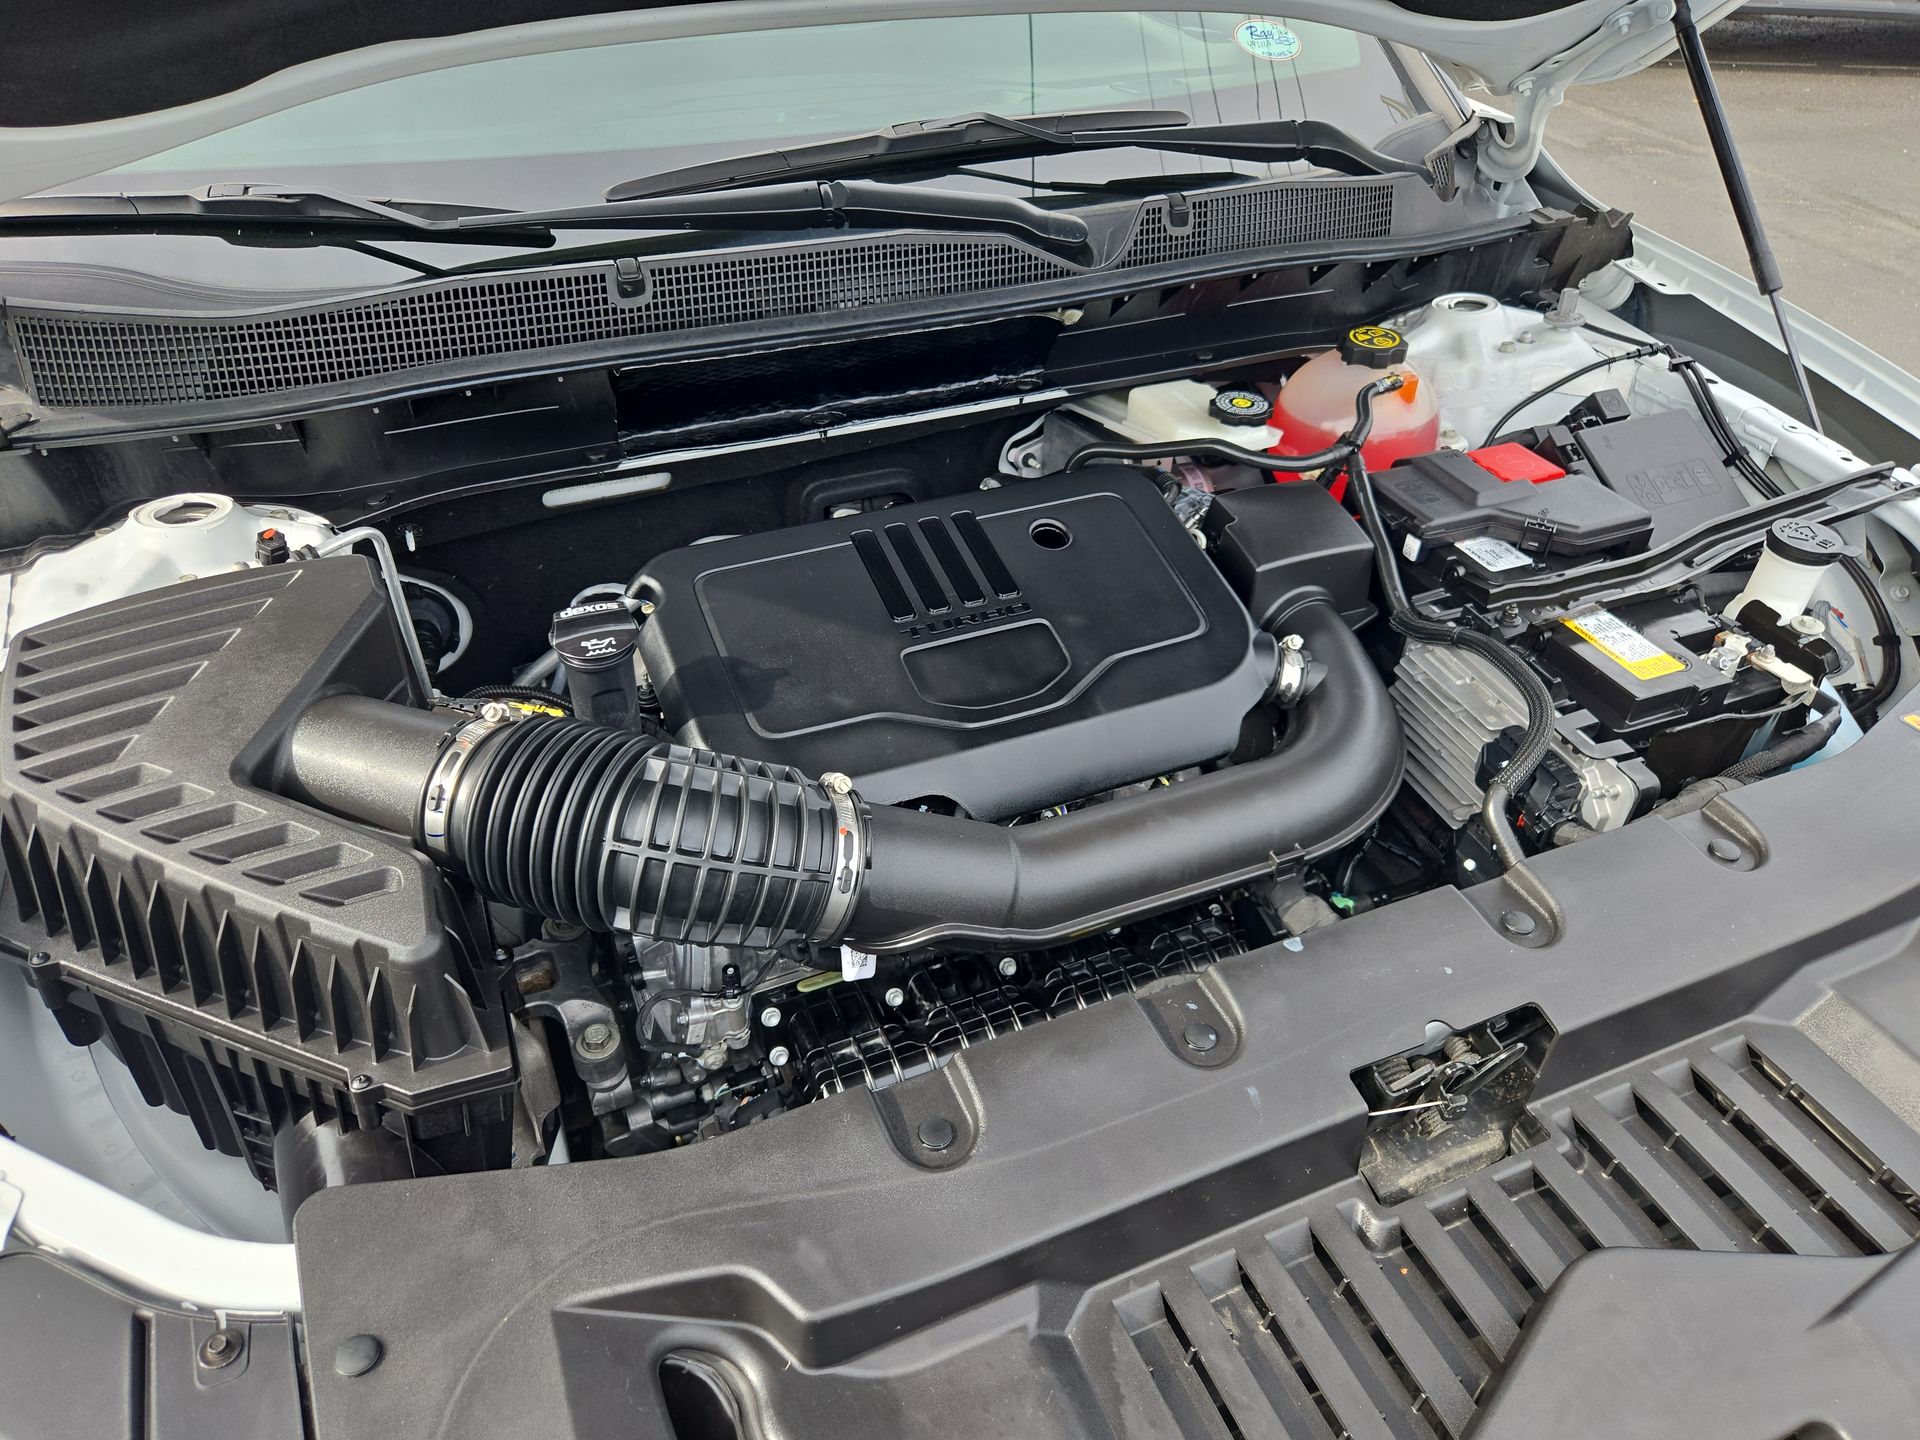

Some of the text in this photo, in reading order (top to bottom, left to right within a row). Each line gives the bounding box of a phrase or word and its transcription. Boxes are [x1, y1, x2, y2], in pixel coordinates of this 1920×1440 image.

[1245, 25, 1275, 40] Ray
[560, 602, 620, 618] dexos
[900, 603, 1032, 638] TURBO
